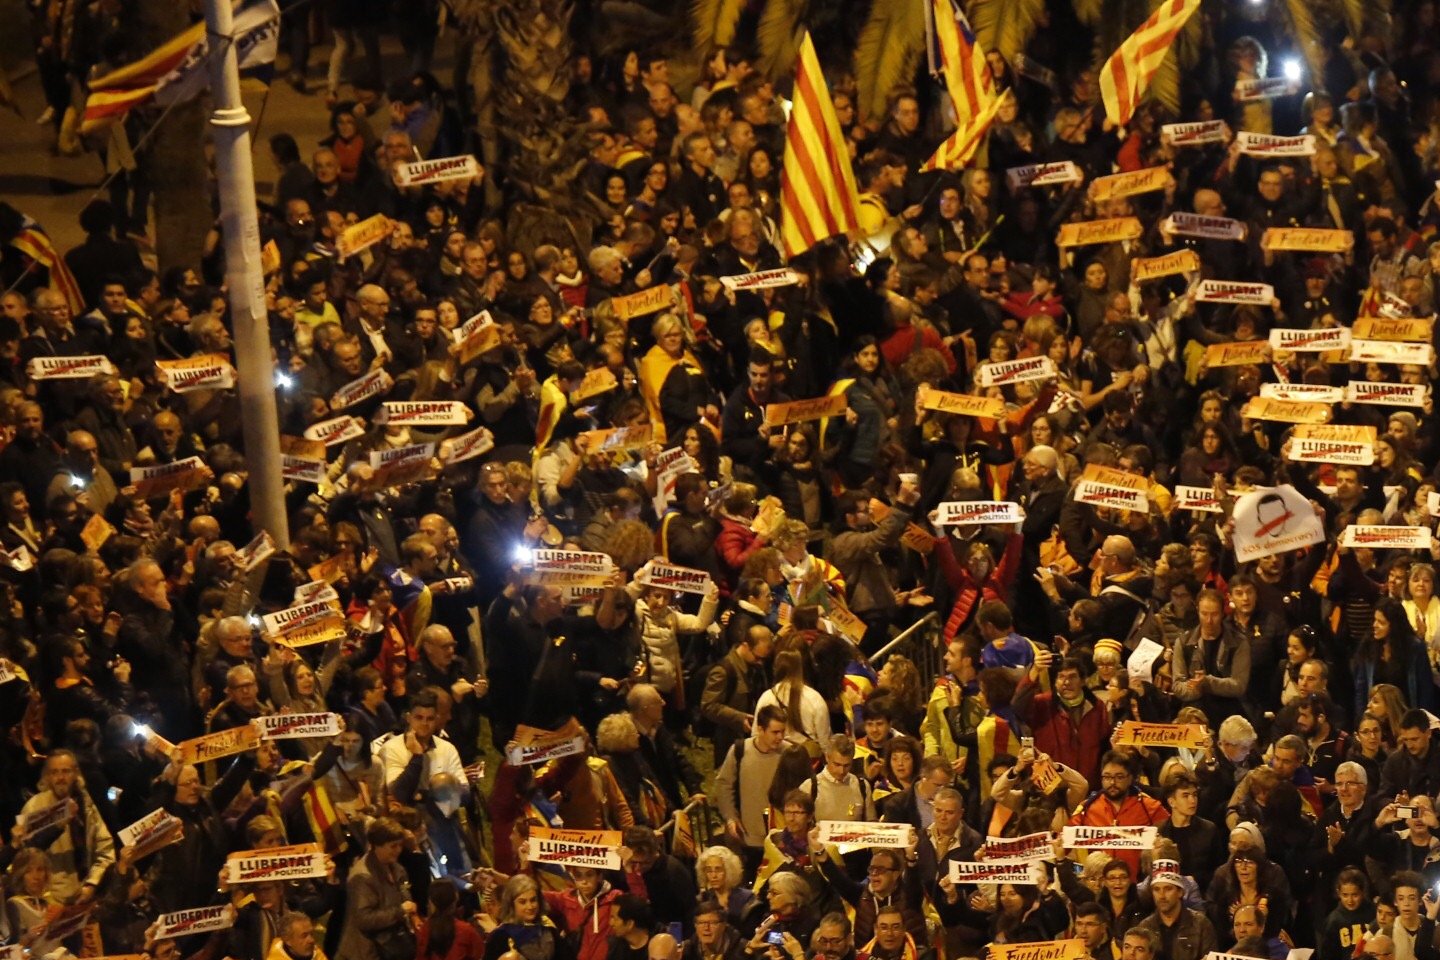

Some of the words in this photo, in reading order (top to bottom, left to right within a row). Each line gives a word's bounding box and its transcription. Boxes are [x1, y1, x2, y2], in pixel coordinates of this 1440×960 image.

[1084, 484, 1138, 502] LLIBERTAT
[947, 505, 1011, 517] LLIBERTAT
[537, 552, 605, 566] LLIBERTAT
[651, 567, 706, 587] LLIBERTAT
[265, 716, 330, 730] LLIBERTAT
[539, 843, 608, 860] LLIBERTAT
[240, 856, 313, 872] LLIBERTAT
[958, 863, 1029, 875] LLIBERTAT
[164, 908, 222, 927] LLIBERTAT
